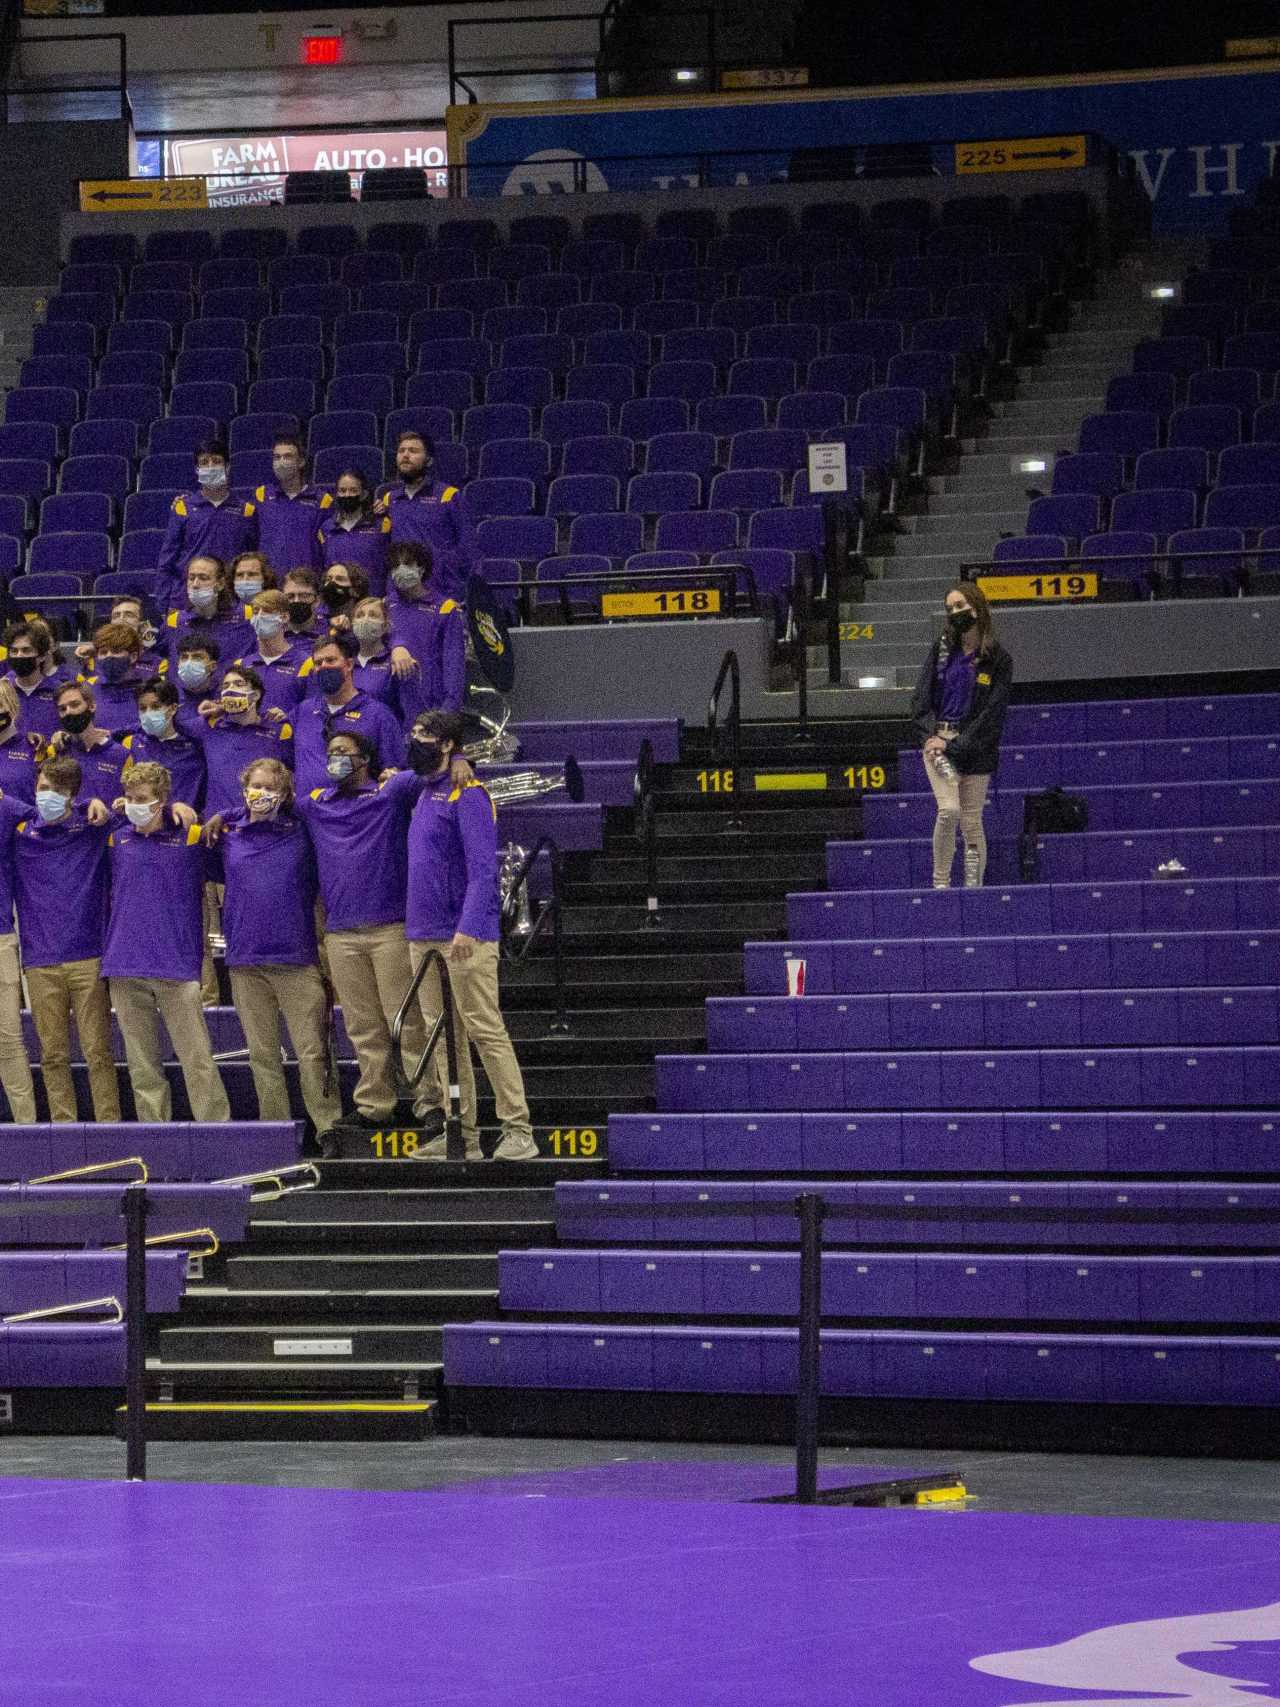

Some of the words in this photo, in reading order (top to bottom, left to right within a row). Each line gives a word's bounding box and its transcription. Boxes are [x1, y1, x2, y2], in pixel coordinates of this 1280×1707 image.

[211, 140, 277, 168] FARM
[314, 148, 387, 171] AUTO
[962, 150, 1007, 167] 225
[207, 160, 280, 188] UREAU
[159, 186, 203, 201] 223
[209, 187, 284, 208] INSURANCE
[1030, 577, 1086, 596] 119
[654, 592, 709, 611] 118
[844, 766, 886, 788] 119
[370, 1131, 419, 1157] 118
[548, 1129, 597, 1156] 119
